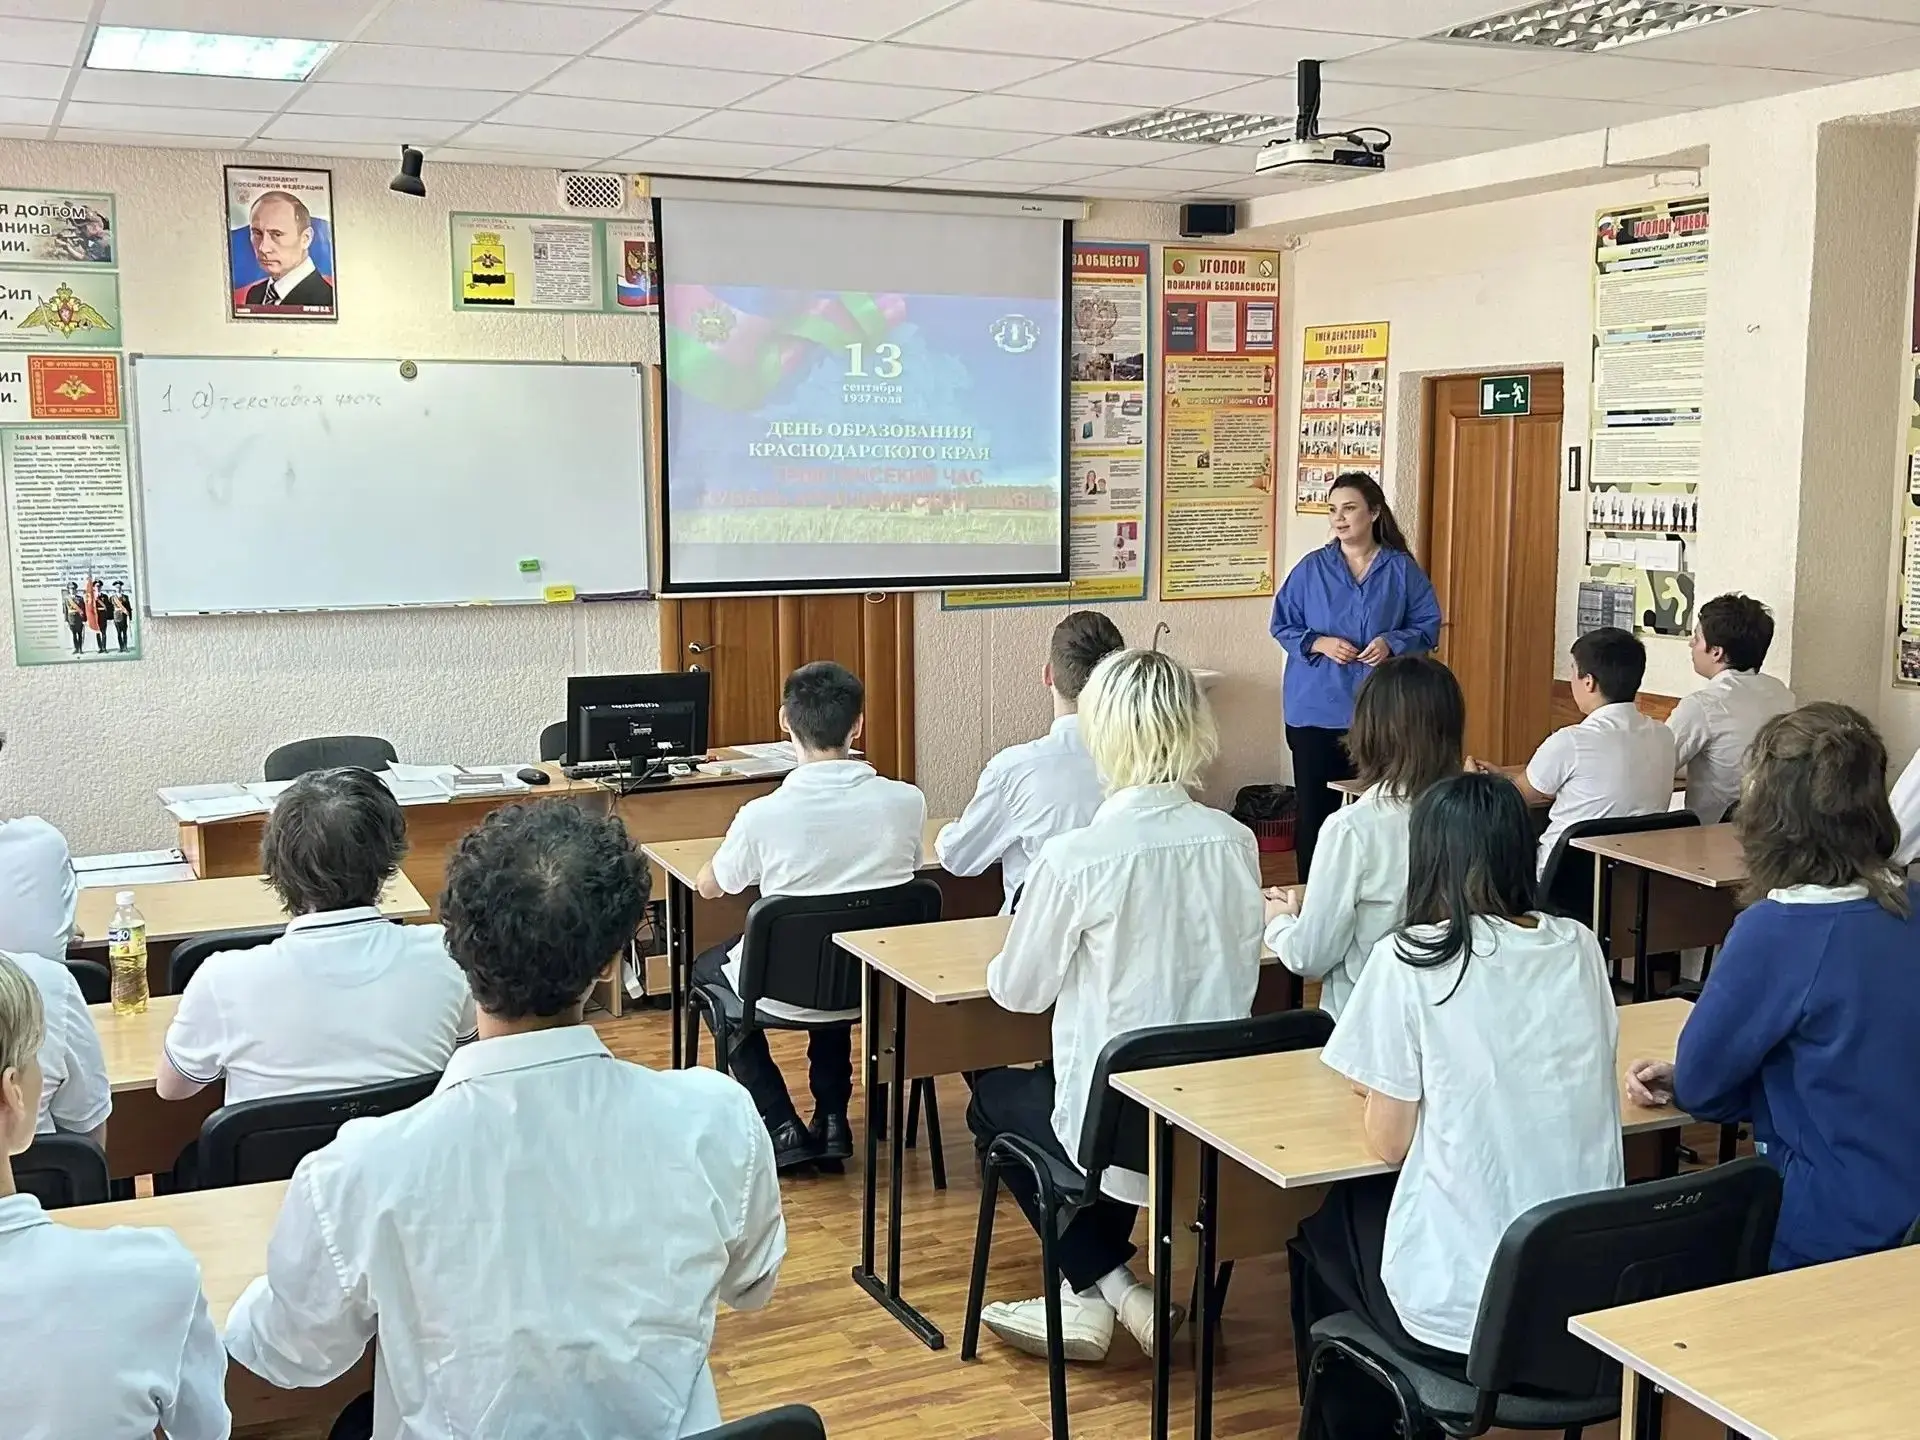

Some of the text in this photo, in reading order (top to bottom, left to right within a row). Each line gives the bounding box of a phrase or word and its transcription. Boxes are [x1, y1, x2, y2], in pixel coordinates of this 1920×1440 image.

[258, 175, 299, 183] ПРЕЗИДЕНТ
[233, 181, 324, 191] РОССИЙСКОЙ ФЕДЕРАЦИИ
[15, 204, 86, 218] долгом
[1634, 218, 1671, 238] УГОЛОК
[0, 240, 30, 252] ии.
[1630, 243, 1675, 255] ДОКУМЕНТАЦИЯ
[1086, 254, 1140, 268] ОБЩЕСТВУ
[1200, 259, 1245, 274] УГОЛОК
[1167, 279, 1276, 292] ПОЖАРНОЙ БЕЗОПАСНОСТИ
[1315, 329, 1377, 342] УМЕЙ ДЕЙСТВОВАТЬ
[1325, 343, 1364, 355] ПРИ ПОЖАРЕ
[844, 343, 903, 378] 13
[843, 382, 903, 395] сентября
[843, 393, 902, 404] 1937 года
[1257, 396, 1269, 406] 01
[15, 432, 115, 441] Знамя воинской части
[766, 421, 973, 440] ДЕНЬ ОБРАЗОВАНИЯ
[748, 442, 990, 460] КРАСНОДАРСКОГО КРАЯ
